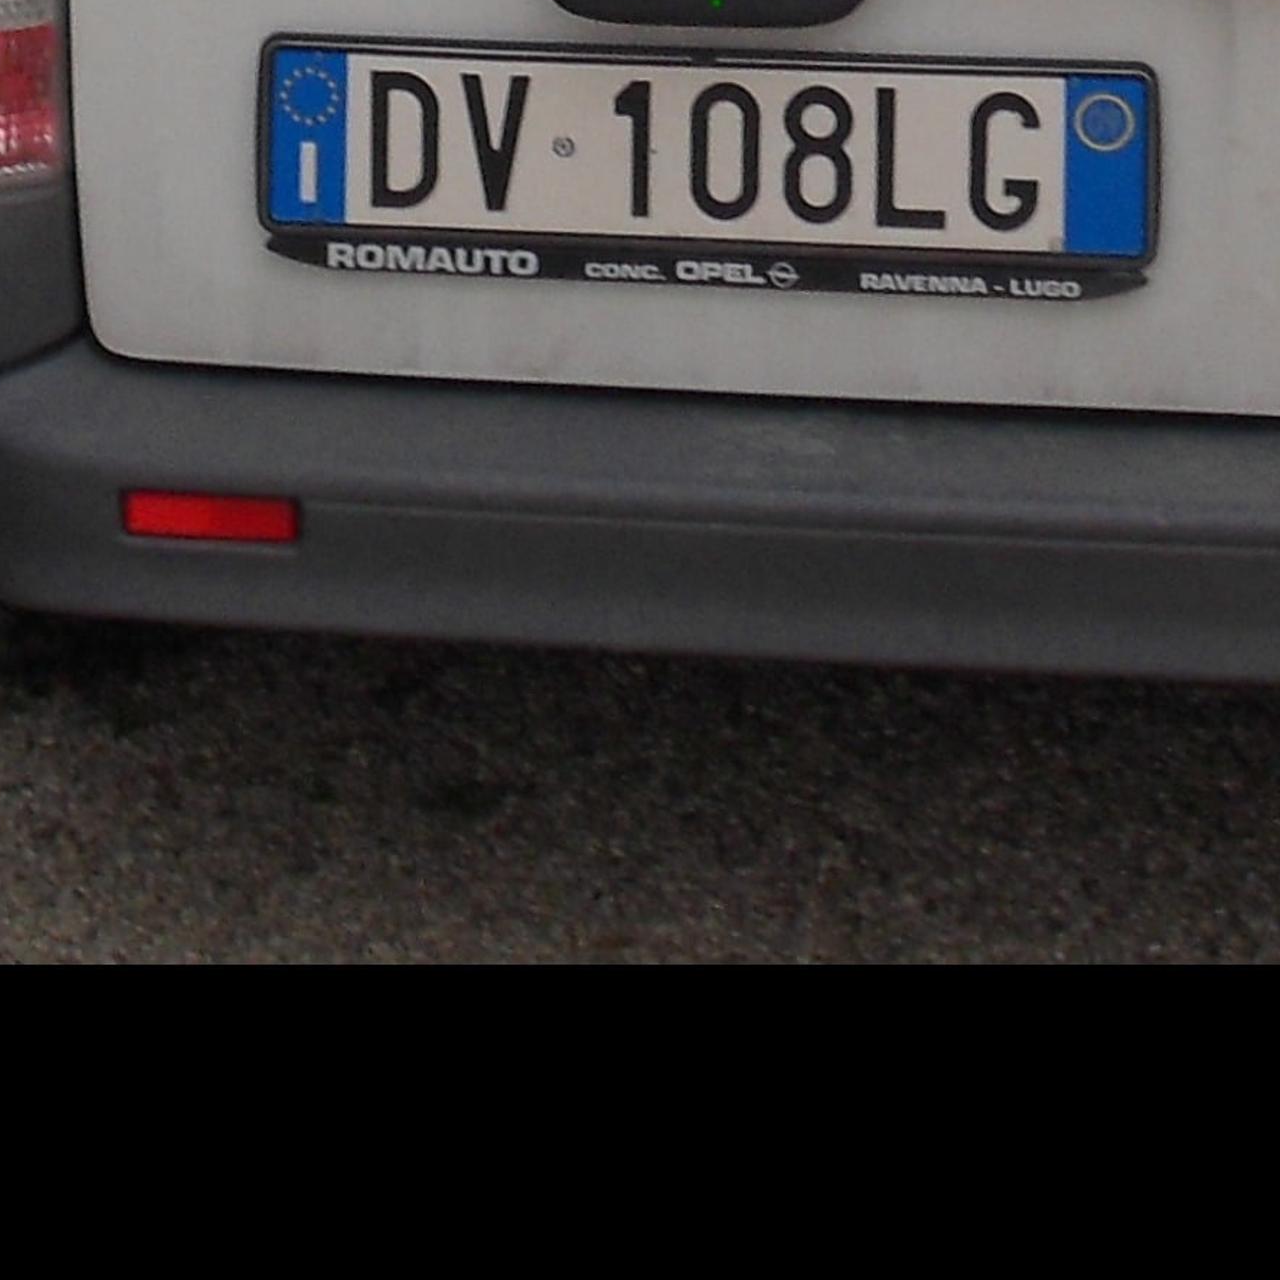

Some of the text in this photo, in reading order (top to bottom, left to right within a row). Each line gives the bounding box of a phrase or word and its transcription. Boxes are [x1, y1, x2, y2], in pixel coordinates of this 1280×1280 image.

[370, 70, 531, 211] DV
[614, 78, 1040, 231] 108LG
[326, 242, 539, 277] ROMAUTO
[584, 262, 666, 281] CONC.
[676, 260, 766, 285] OPEL
[860, 272, 988, 295] RAVENNA
[1010, 279, 1082, 299] LUGO
